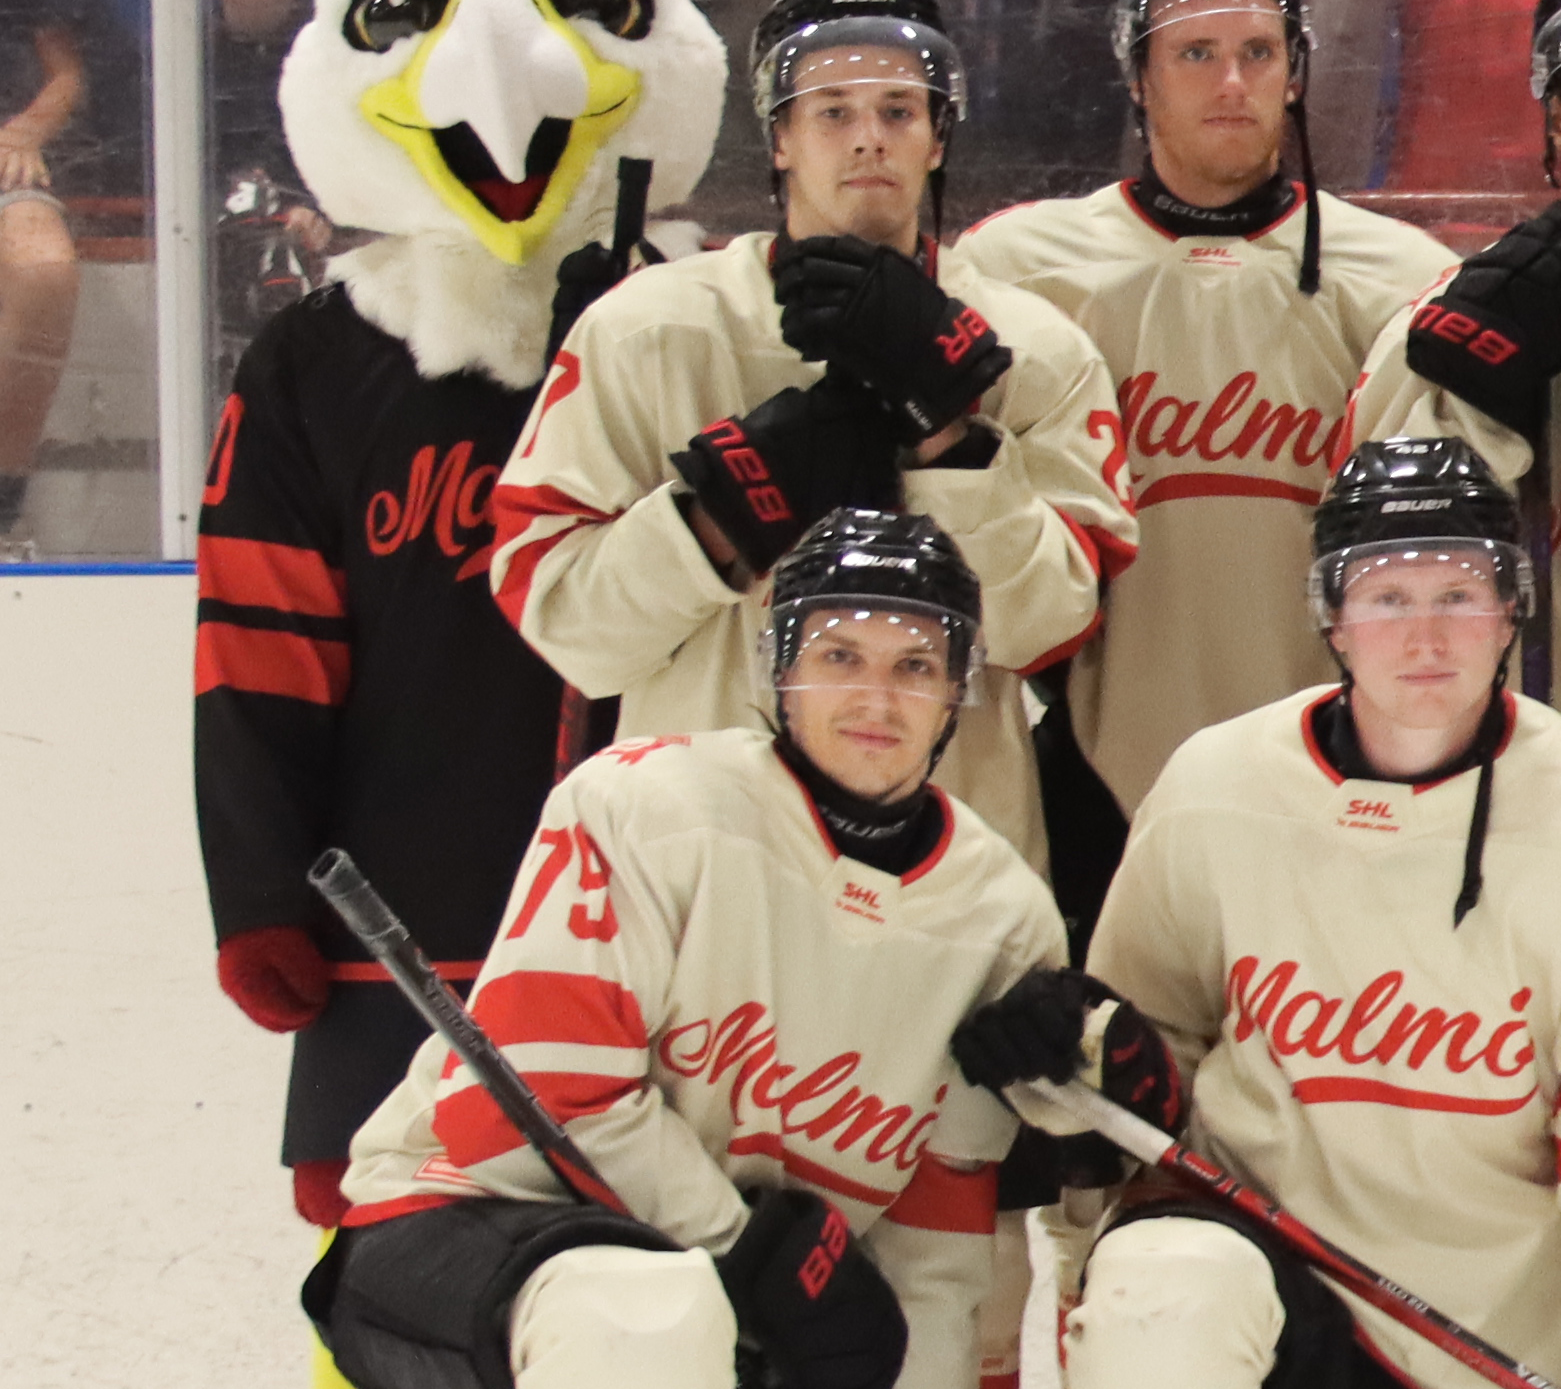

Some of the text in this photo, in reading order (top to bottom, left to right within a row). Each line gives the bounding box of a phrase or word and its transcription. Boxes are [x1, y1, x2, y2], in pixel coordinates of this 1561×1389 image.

[1189, 246, 1235, 259] SHL
[1406, 304, 1520, 368] BAU
[700, 414, 794, 525] BAU
[1380, 496, 1453, 515] BAUER
[1345, 798, 1394, 819] SHL
[506, 822, 620, 944] 79
[841, 881, 882, 911] SHL
